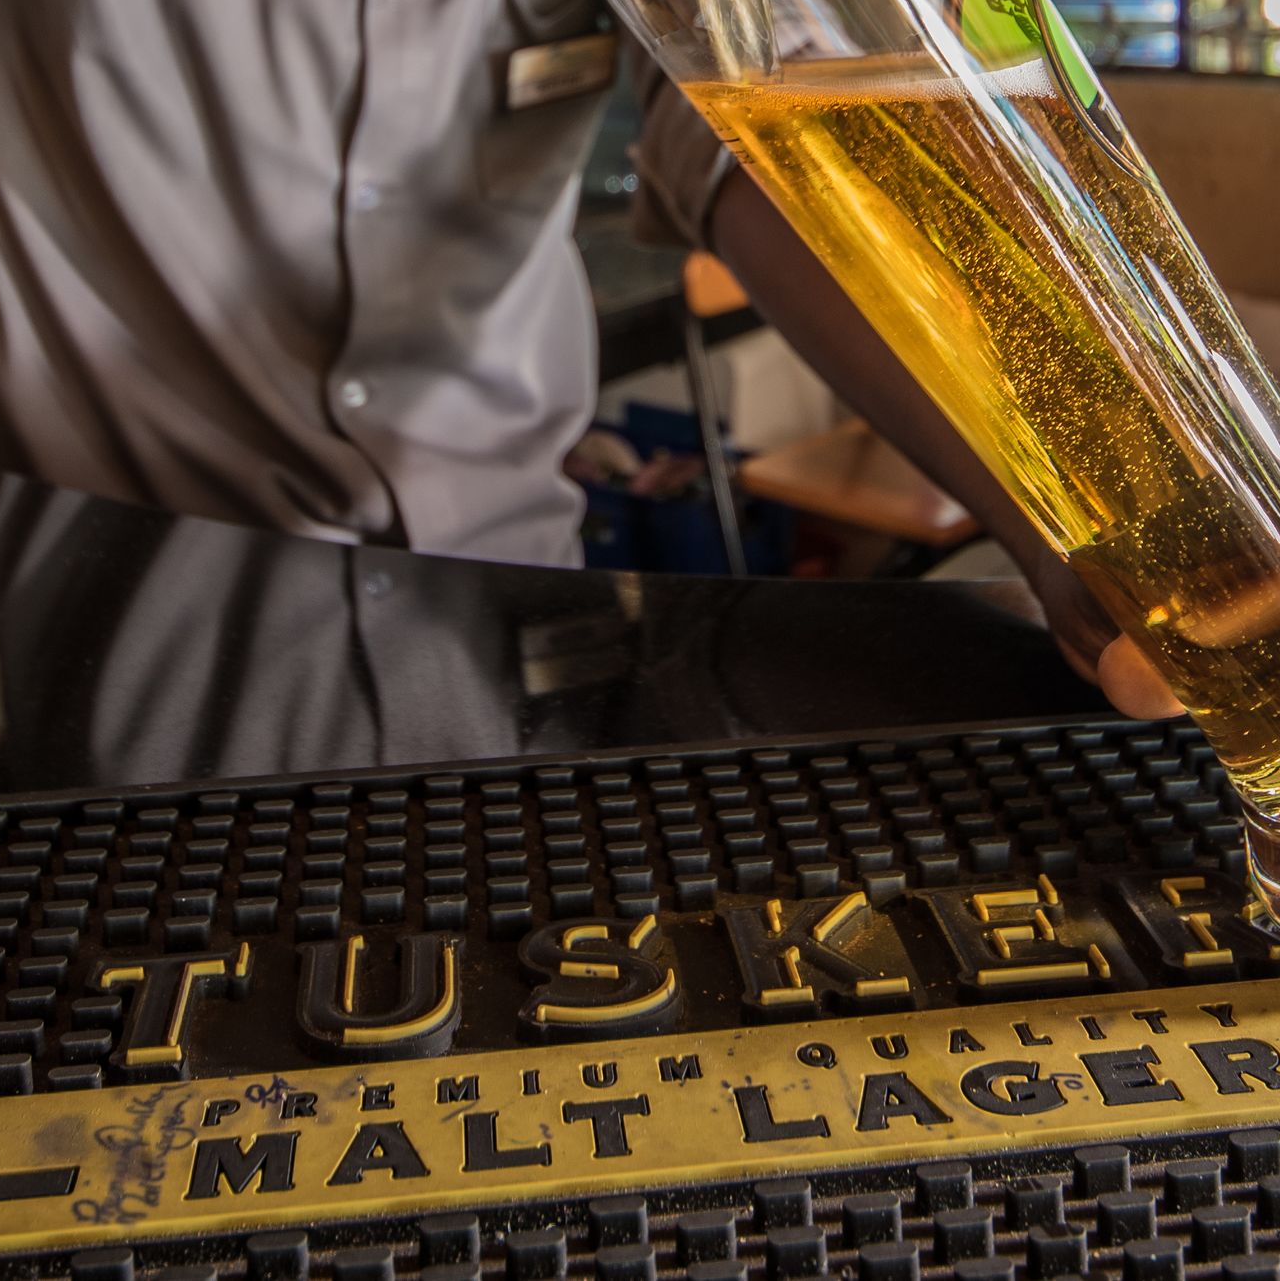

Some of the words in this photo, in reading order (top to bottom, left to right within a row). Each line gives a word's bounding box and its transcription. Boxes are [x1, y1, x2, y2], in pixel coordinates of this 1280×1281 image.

[201, 1053, 704, 1127] PREMIUM
[796, 1001, 1239, 1070] QUALITY
[183, 1092, 651, 1202] MALT
